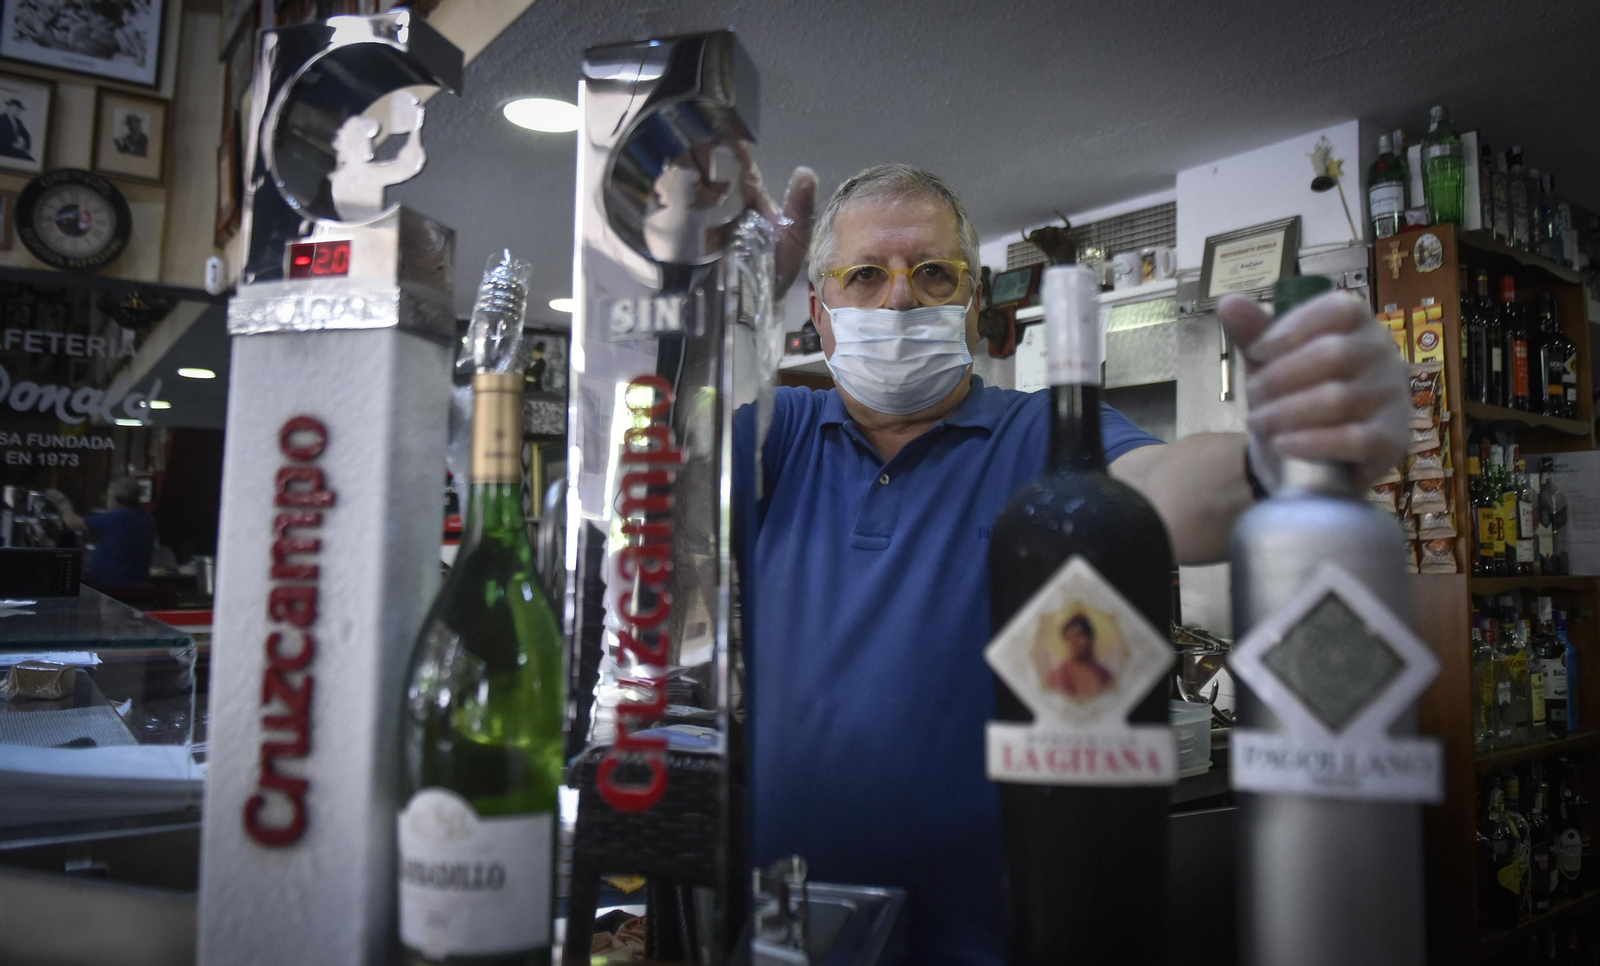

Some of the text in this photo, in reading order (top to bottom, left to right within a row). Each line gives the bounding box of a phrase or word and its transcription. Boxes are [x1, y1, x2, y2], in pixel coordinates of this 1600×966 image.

[610, 297, 682, 335] SIN
[0, 327, 136, 359] FETERIA
[26, 433, 116, 450] FUNDADA
[6, 452, 80, 467] EN 1973
[596, 374, 685, 813] Cruzcampo
[243, 415, 336, 847] Cruzcampo
